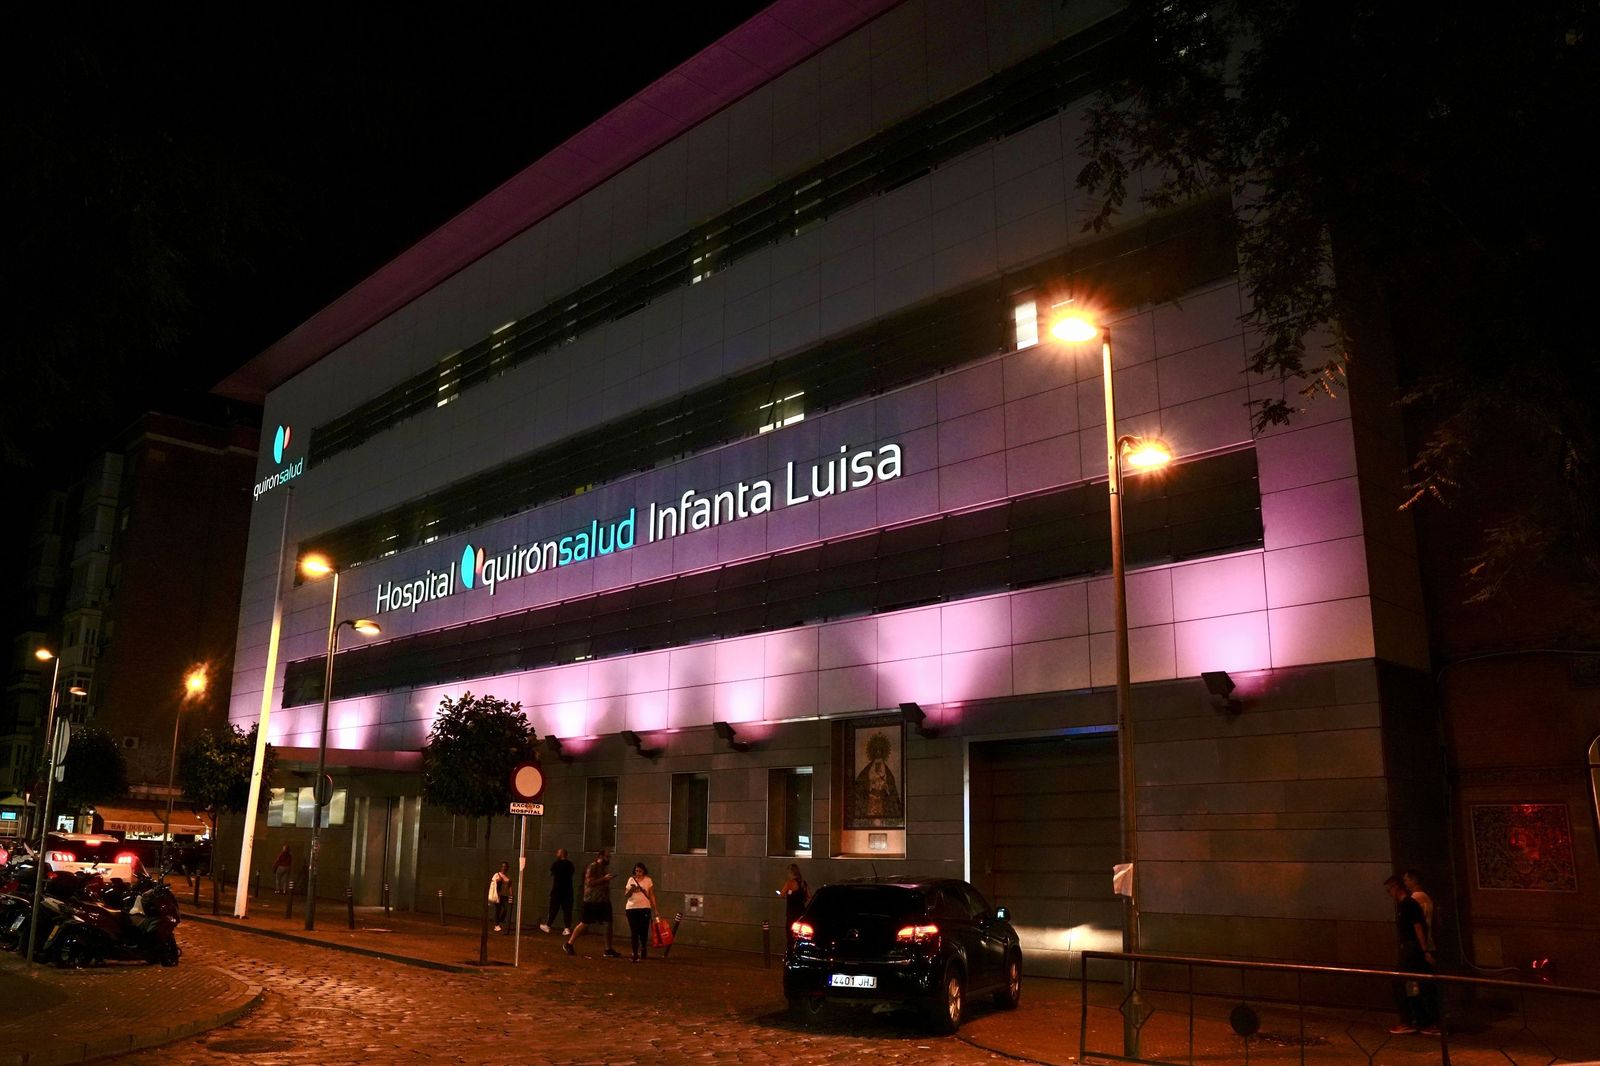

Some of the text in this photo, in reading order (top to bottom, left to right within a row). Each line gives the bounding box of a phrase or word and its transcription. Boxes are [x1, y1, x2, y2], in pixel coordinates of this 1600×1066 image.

[376, 443, 904, 614] Hospital quirónsalud Infanta Luisa
[833, 977, 875, 987] 4401 JHJ
